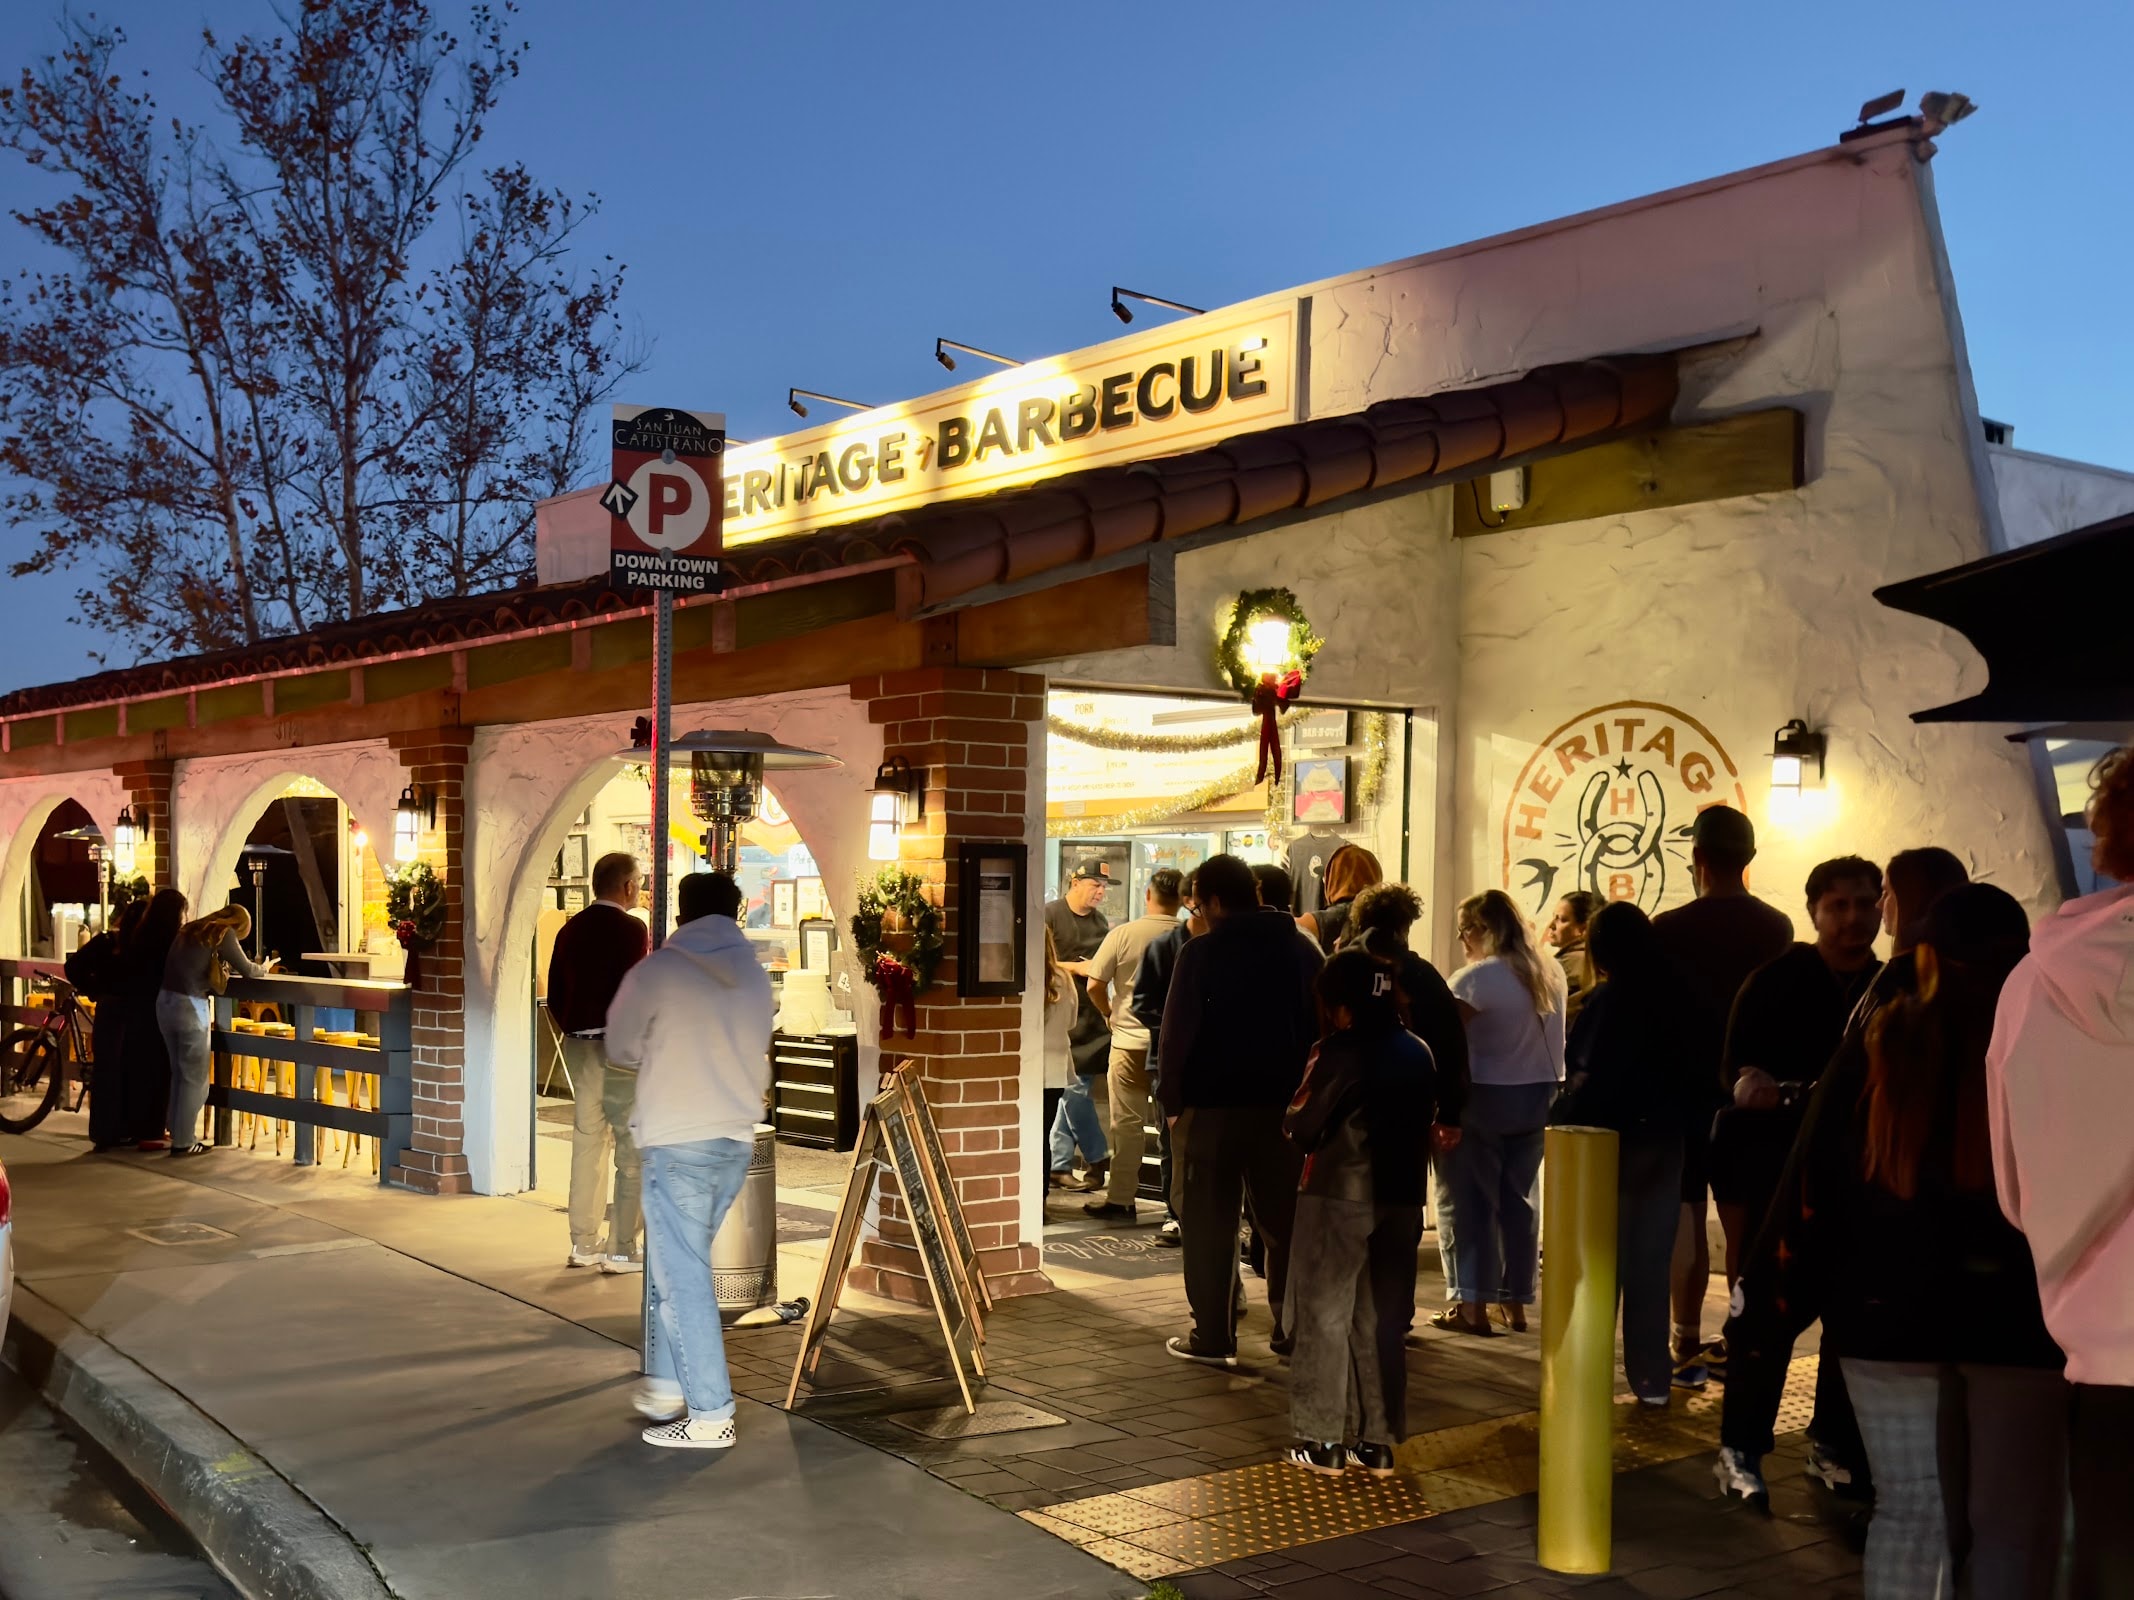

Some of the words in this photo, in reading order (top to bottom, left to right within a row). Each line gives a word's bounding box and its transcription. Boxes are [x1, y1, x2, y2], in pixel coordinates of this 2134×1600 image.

[637, 418, 663, 432] SAN
[668, 421, 702, 436] JUAN
[724, 432, 906, 518] ERITAGE
[938, 337, 1267, 470] BARBECUE
[615, 428, 723, 454] CAPISTRANO
[649, 473, 692, 535] P
[615, 554, 719, 574] DOWNTOWN
[627, 572, 705, 590] PARKING
[1514, 718, 1729, 841] HERITAG
[1610, 788, 1635, 816] H
[1609, 874, 1635, 900] B
